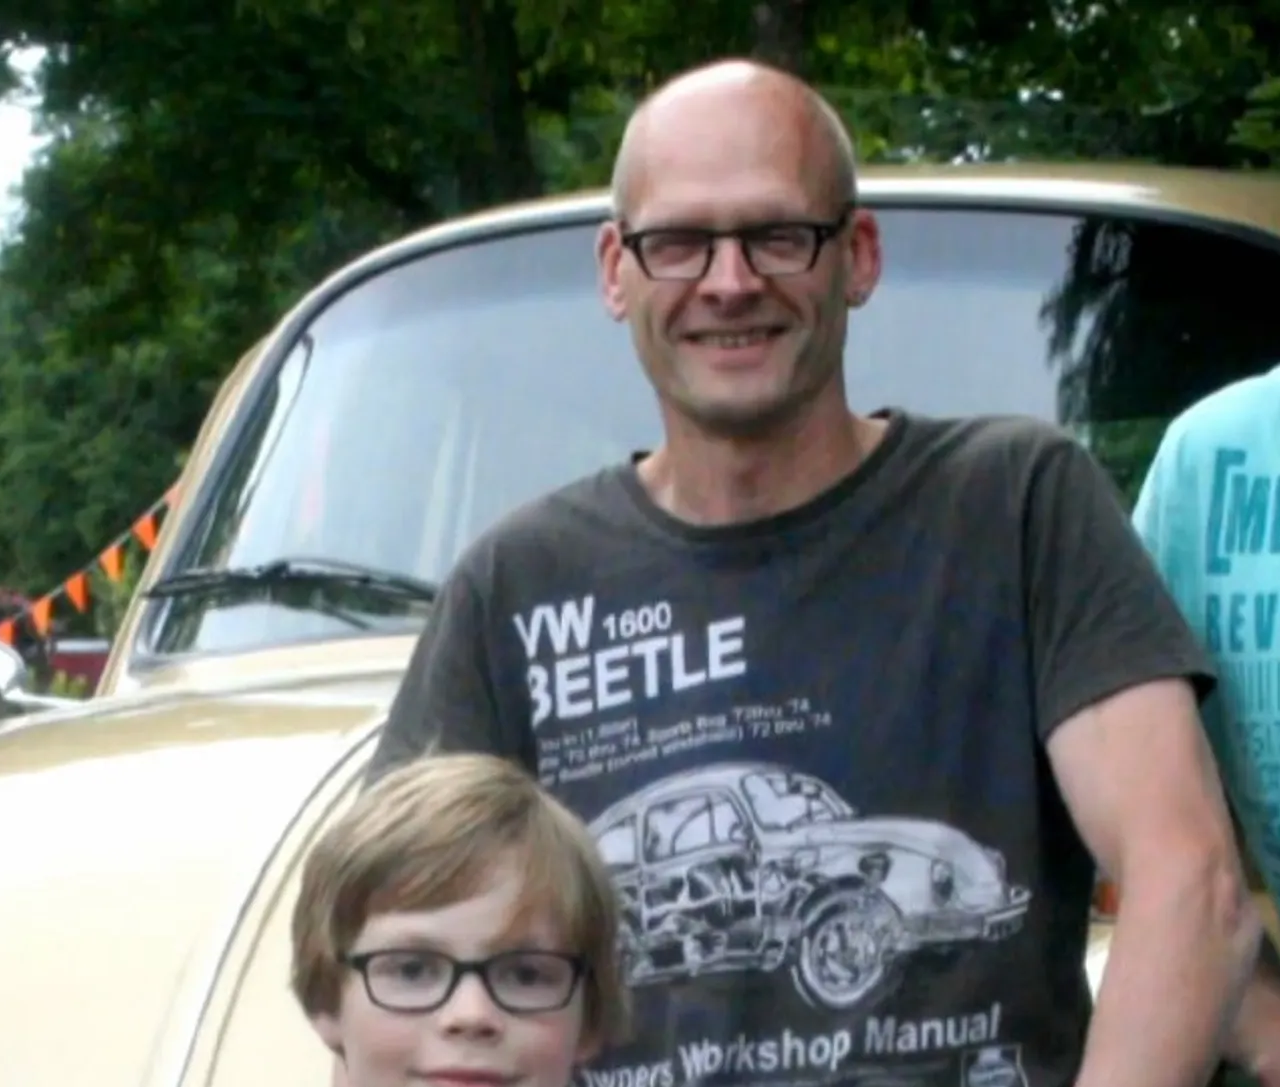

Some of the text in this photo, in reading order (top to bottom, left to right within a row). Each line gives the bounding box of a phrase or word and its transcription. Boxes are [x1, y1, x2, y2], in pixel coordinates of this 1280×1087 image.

[513, 593, 672, 660] VW 1600
[527, 616, 747, 731] BEETLE
[678, 1027, 852, 1082] Workshop
[863, 1001, 1002, 1055] Manual
